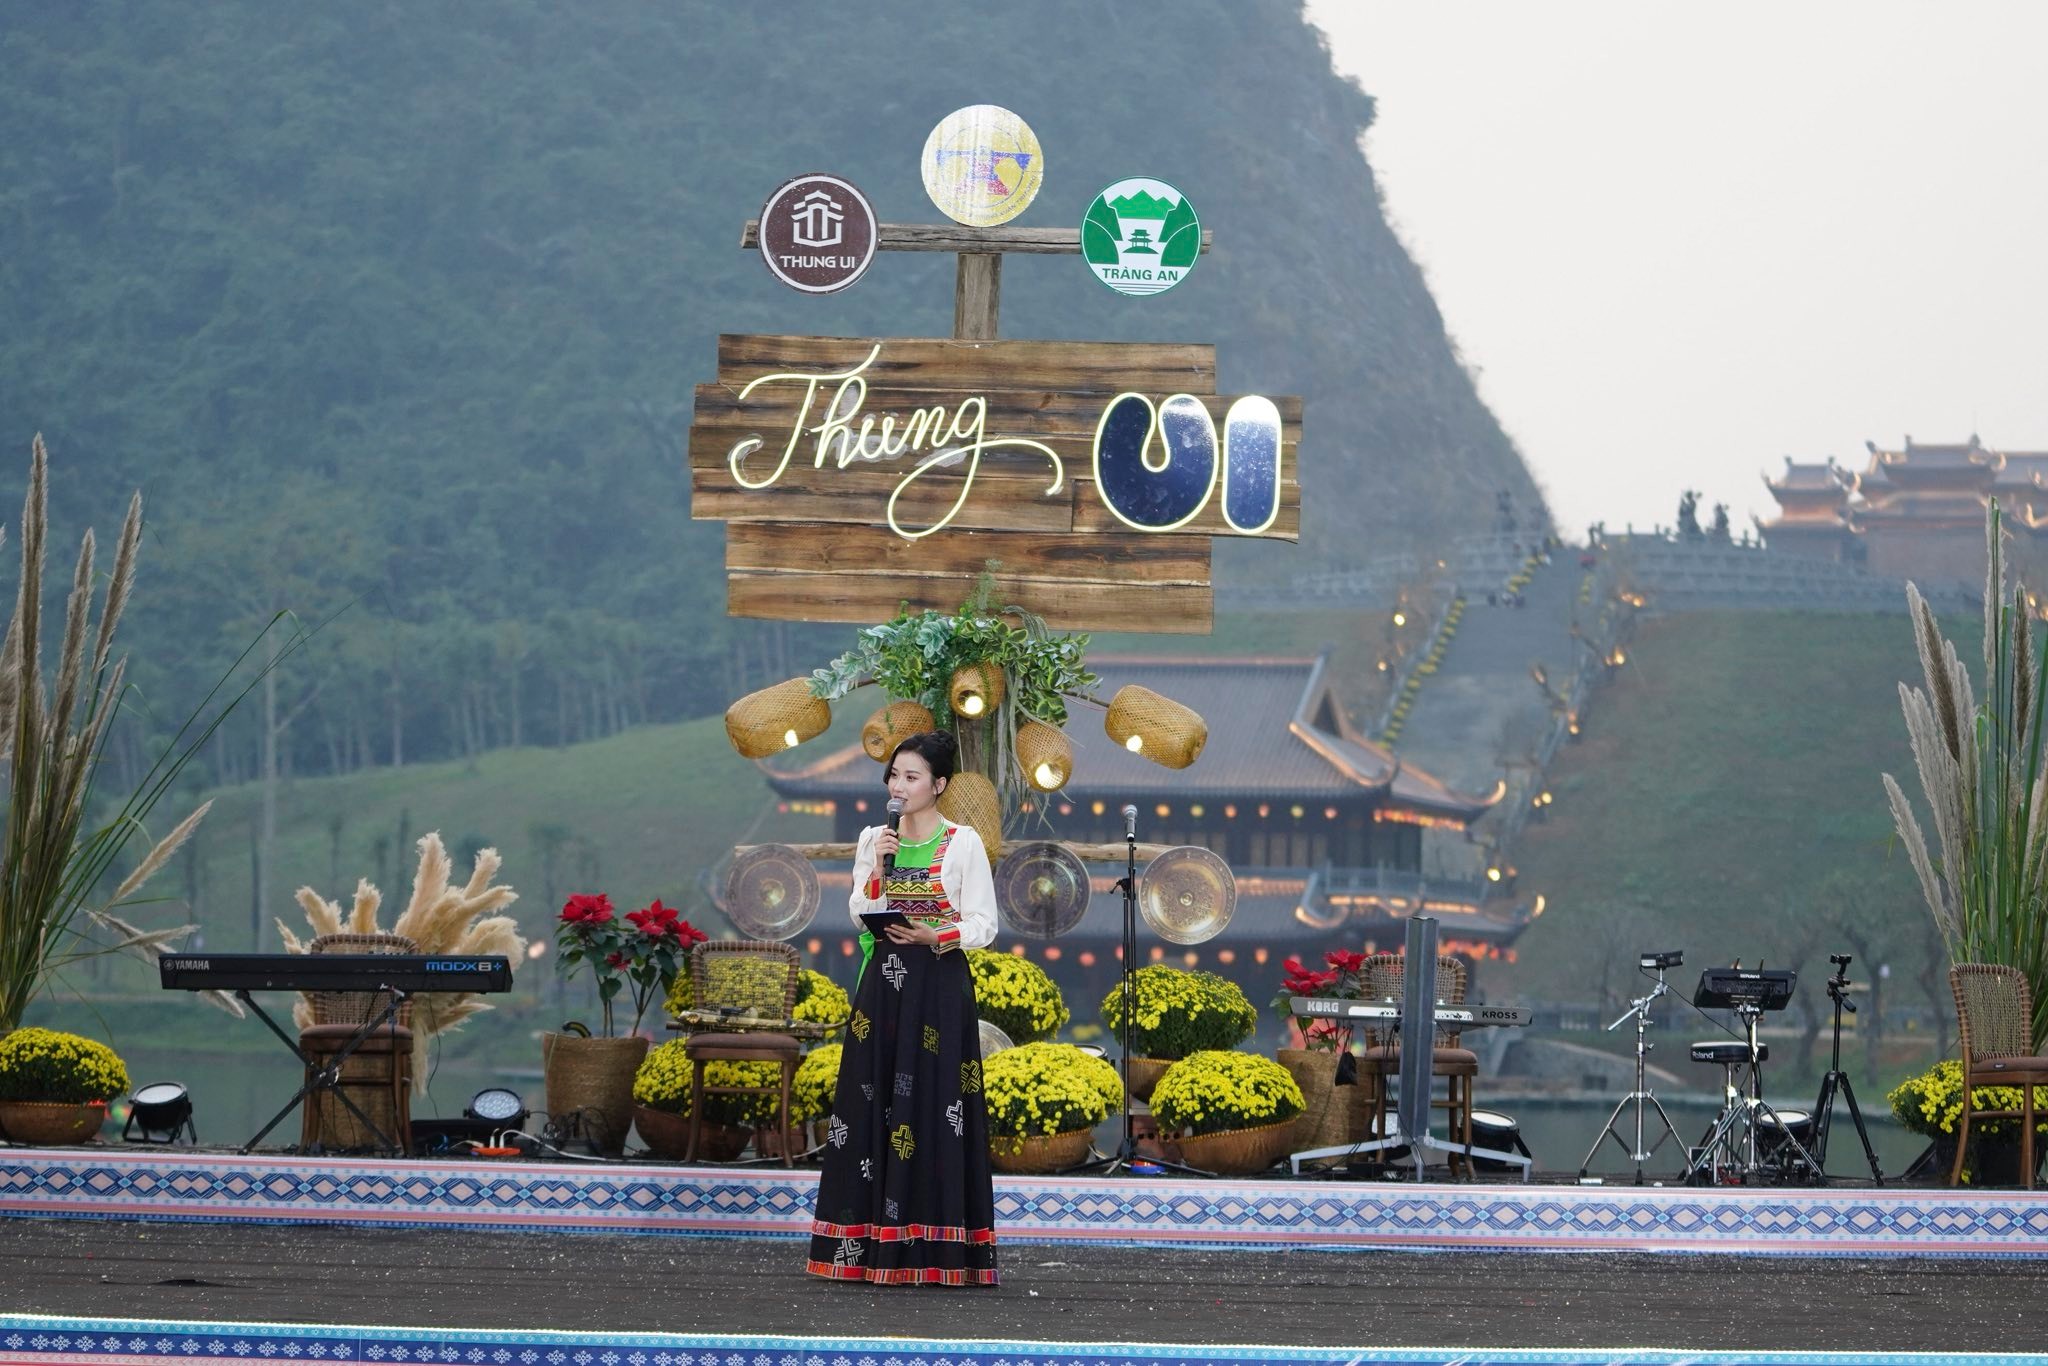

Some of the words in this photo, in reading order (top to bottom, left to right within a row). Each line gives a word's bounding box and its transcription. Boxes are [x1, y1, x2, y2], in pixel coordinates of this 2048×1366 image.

[780, 255, 836, 269] THUNG
[840, 256, 856, 269] UI
[1102, 266, 1152, 280] TRÀNG
[1157, 270, 1178, 281] AN
[1093, 393, 1282, 535] UI
[175, 960, 210, 970] YAMAHA
[1307, 1001, 1339, 1012] KORG
[1482, 1010, 1518, 1020] KROSS
[1692, 1051, 1714, 1060] Roland
